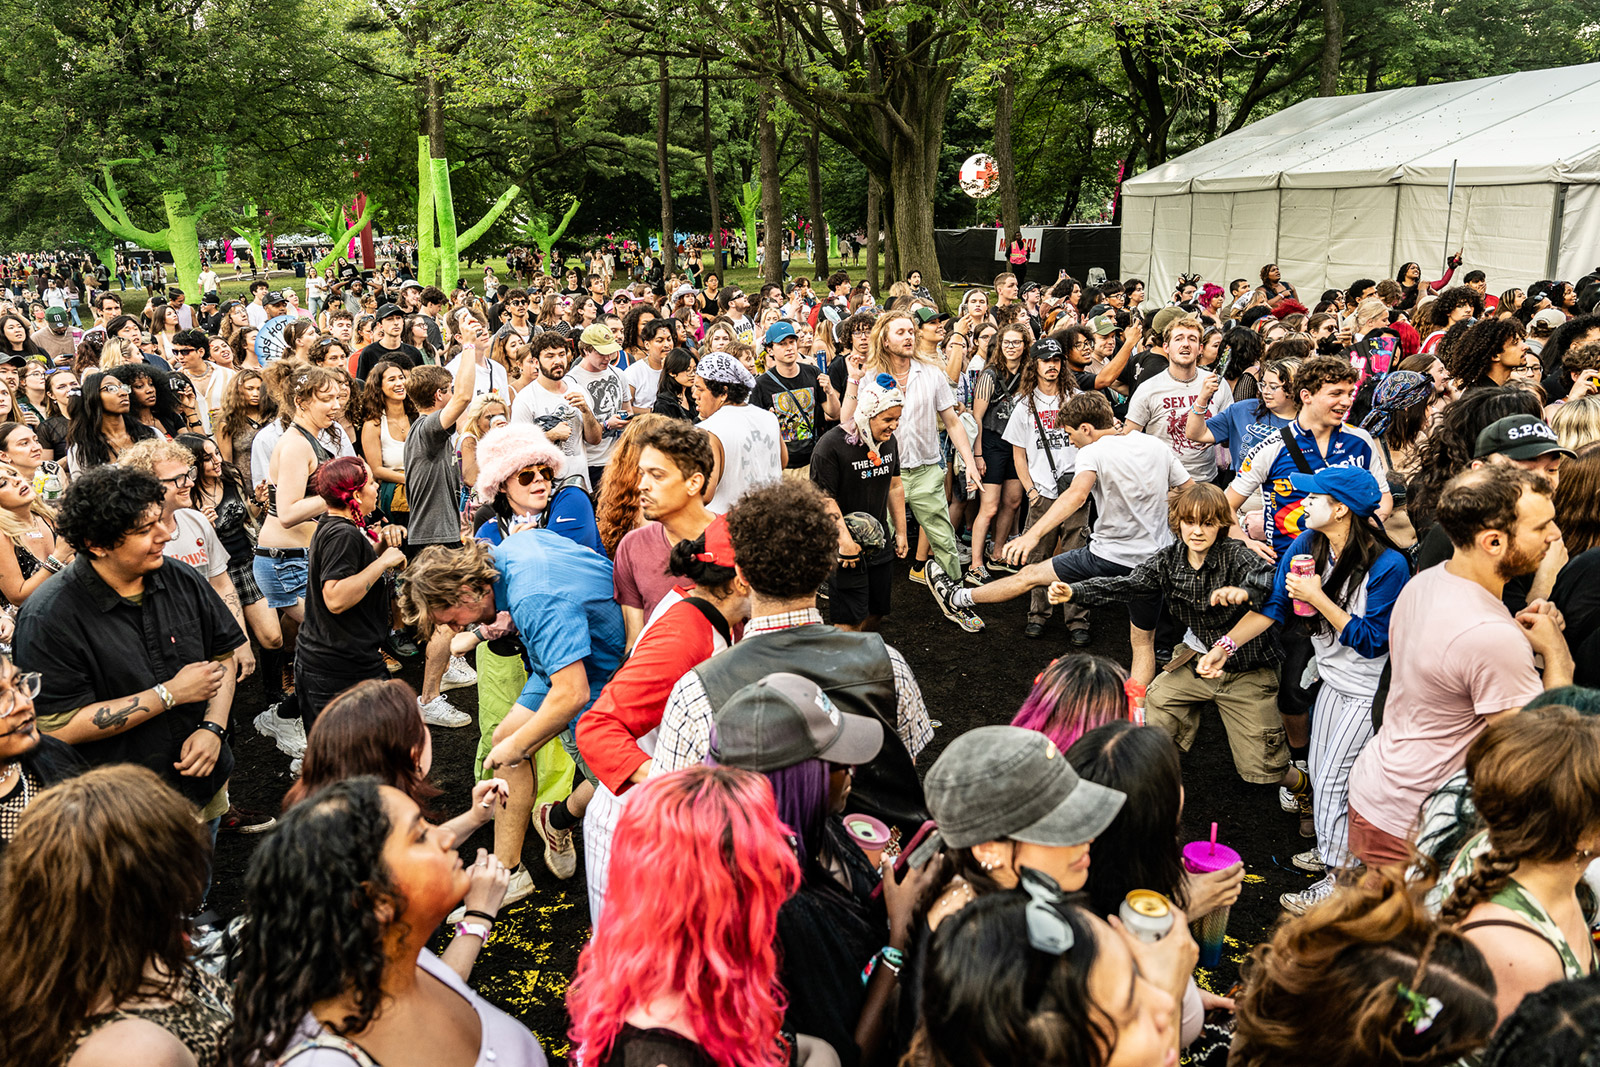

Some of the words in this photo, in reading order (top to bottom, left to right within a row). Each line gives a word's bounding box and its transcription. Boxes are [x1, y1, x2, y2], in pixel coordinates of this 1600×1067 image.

[268, 319, 288, 338] HOT
[1163, 396, 1186, 409] SEX
[852, 460, 869, 470] THE
[869, 453, 893, 468] SRY
[873, 466, 889, 477] FAR
